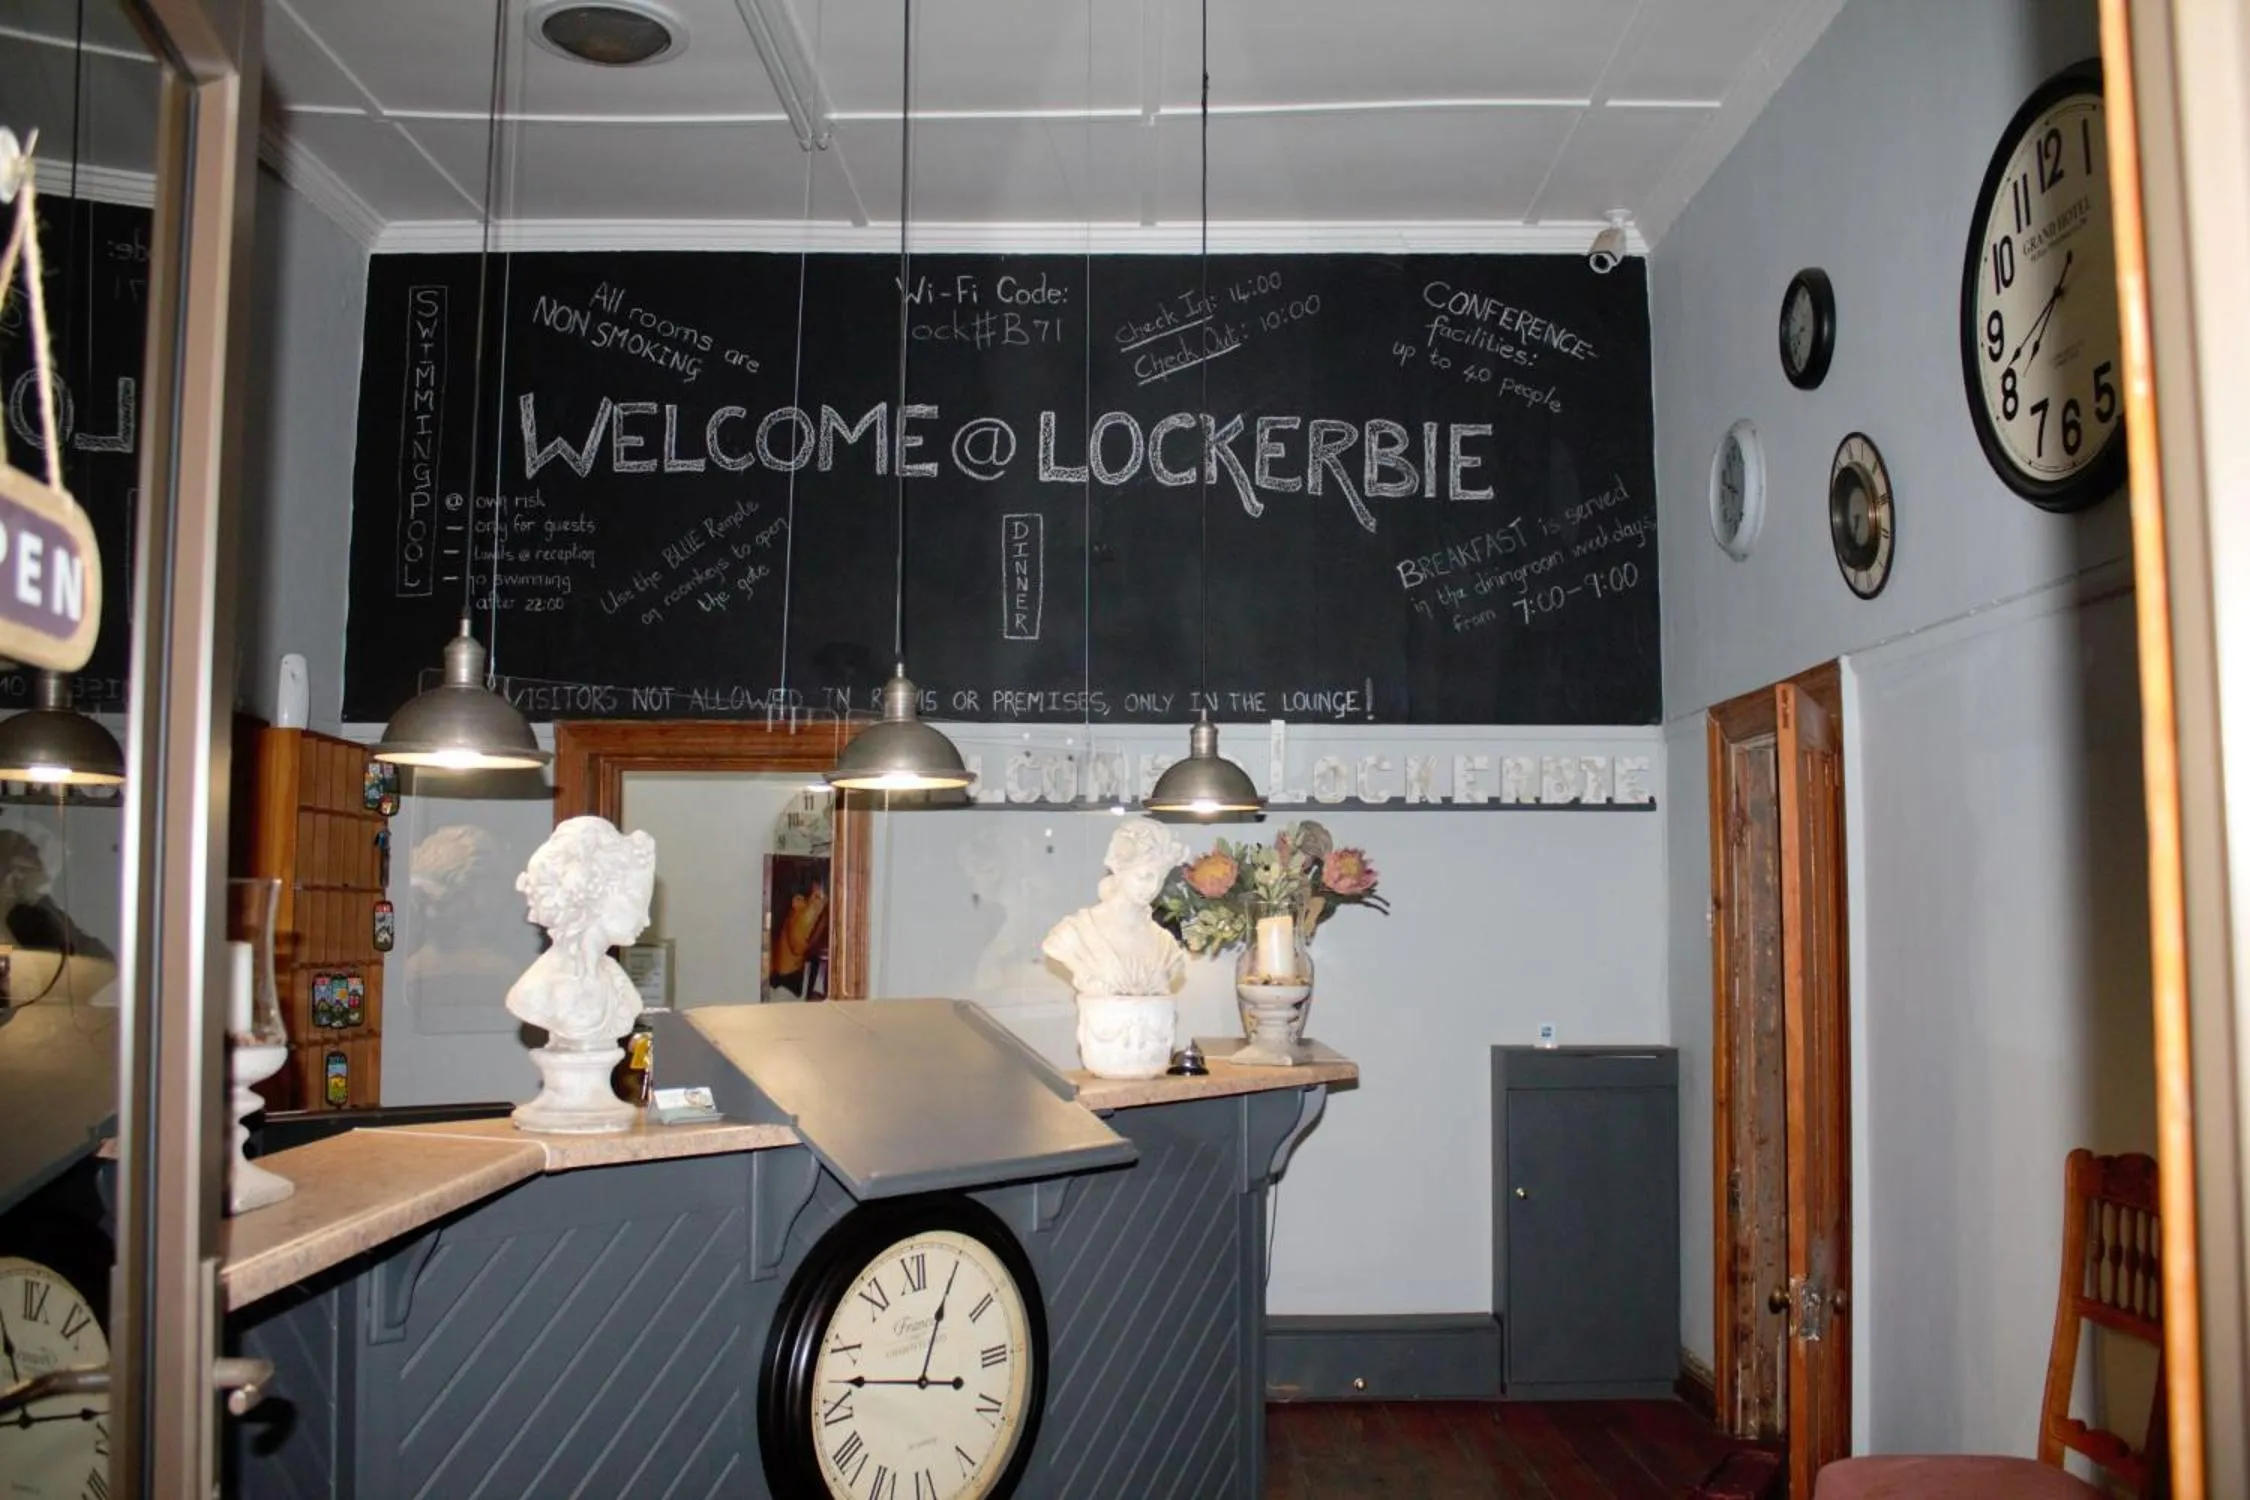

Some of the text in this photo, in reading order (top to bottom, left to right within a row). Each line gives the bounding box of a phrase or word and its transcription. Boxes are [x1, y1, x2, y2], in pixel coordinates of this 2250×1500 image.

[2037, 127, 2065, 194] 12
[2082, 118, 2092, 175] 1
[2013, 174, 2031, 234] 11
[896, 272, 1068, 305] Wi-Fi Code:
[1229, 271, 1283, 303] 14:00
[1992, 235, 2014, 294] 10
[532, 295, 705, 384] NON SMOKING
[590, 280, 761, 374] All rooms are
[1261, 294, 1321, 332] 10:00
[1425, 315, 1538, 366] facilities:
[1987, 311, 2004, 362] 9
[1393, 341, 1562, 413] up to 40 people
[2002, 367, 2018, 421] 8
[2094, 361, 2116, 424] 5
[2030, 397, 2050, 458] 7
[2061, 398, 2083, 456] 6
[519, 392, 1495, 534] WELCOME @ LOCKERBIE
[514, 486, 546, 508] risk
[513, 512, 537, 532] for
[544, 512, 596, 542] guests
[1396, 474, 1631, 589] BREAKFAST is served
[535, 543, 596, 568] reception
[600, 589, 636, 615] Use
[632, 570, 663, 591] the
[661, 528, 706, 569] BLUE
[641, 608, 665, 625] on
[731, 543, 752, 559] to
[755, 517, 788, 548] open
[525, 597, 564, 612] 22:00
[696, 564, 770, 613] the gate
[1410, 597, 1433, 620] in
[1436, 582, 1468, 609] the
[1452, 609, 1497, 633] from
[503, 676, 618, 712] VISITORS
[632, 687, 673, 711] NOT
[690, 686, 802, 713] ALLOWED
[953, 691, 979, 713] OR
[992, 690, 1111, 718] PREMISES,
[1125, 691, 1171, 714] ONLY
[1189, 691, 1218, 712] IN
[1230, 690, 1266, 712] THE
[1268, 720, 1650, 804] LOCKERBIE
[899, 1253, 927, 1296] XII
